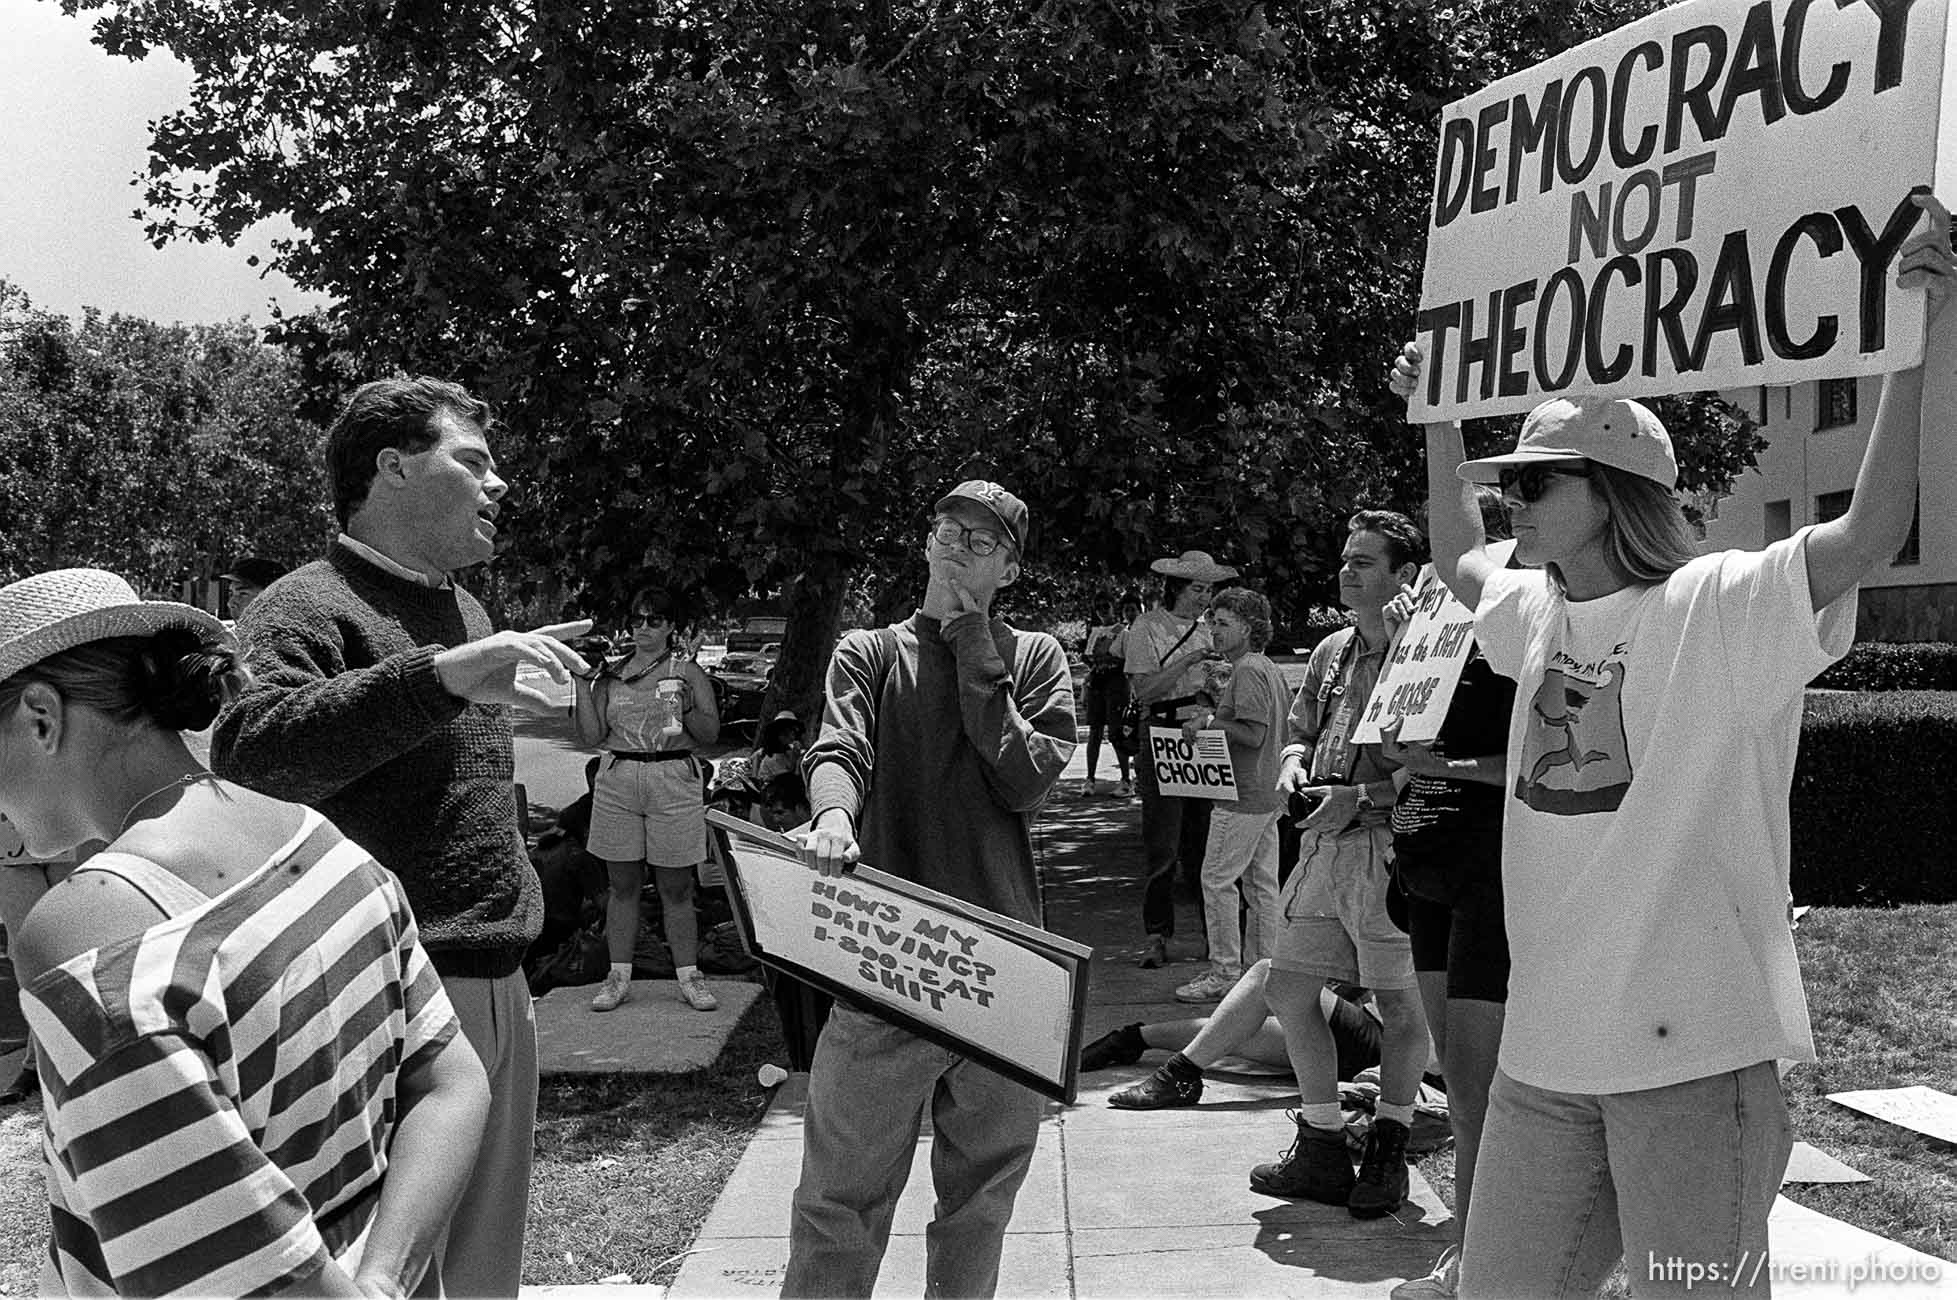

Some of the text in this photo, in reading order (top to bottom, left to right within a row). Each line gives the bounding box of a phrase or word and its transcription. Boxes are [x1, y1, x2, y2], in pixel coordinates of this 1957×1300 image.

[1435, 0, 1914, 228] DEMOCRACY
[1567, 152, 1717, 264] NOT
[1418, 185, 1931, 407] THEOCRACY
[1430, 621, 1473, 658] RIGHT
[1152, 736, 1193, 761] PRO
[1156, 762, 1235, 787] CHOICE
[811, 902, 996, 986] DRIVING?
[913, 918, 979, 957] MY
[858, 960, 946, 1012] SHIT
